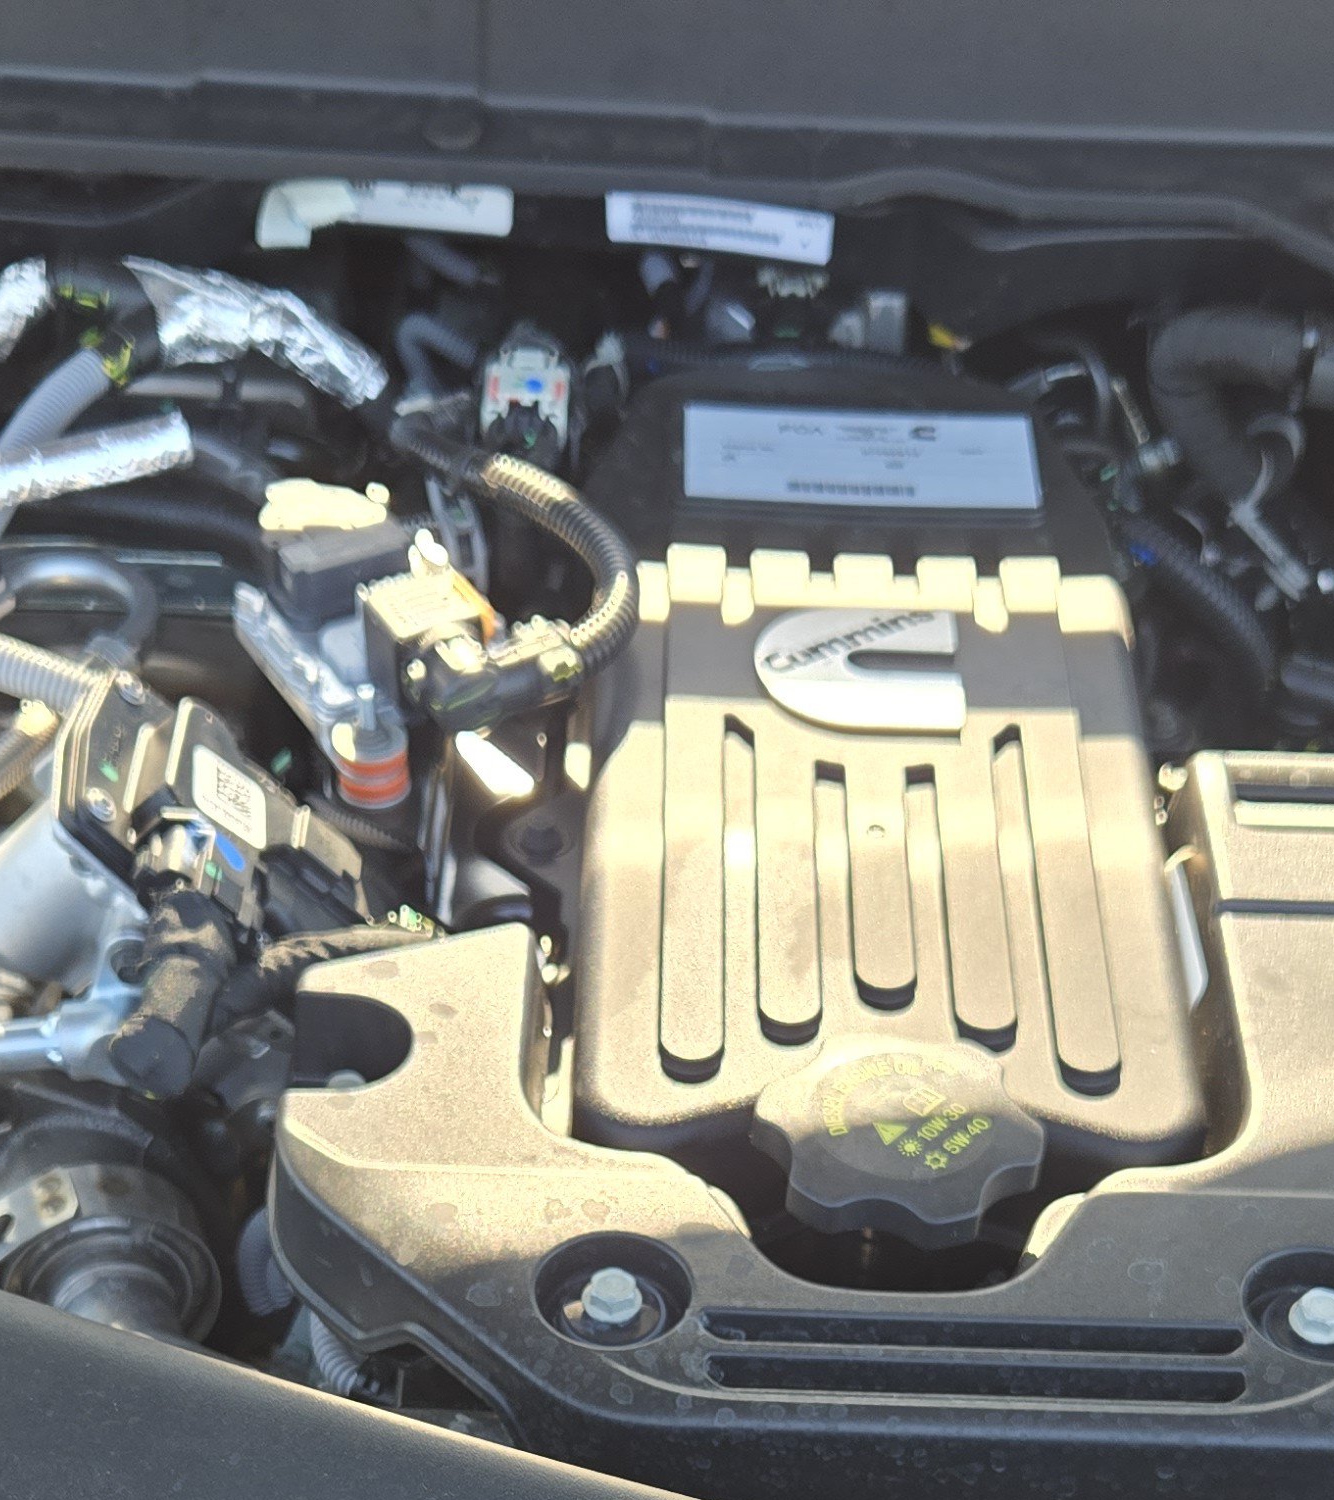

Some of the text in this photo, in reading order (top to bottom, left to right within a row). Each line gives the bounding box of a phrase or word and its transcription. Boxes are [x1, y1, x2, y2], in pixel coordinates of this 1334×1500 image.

[763, 610, 934, 673] Cummins
[916, 1103, 968, 1141] 10W-30
[942, 1117, 992, 1155] 5W-40
